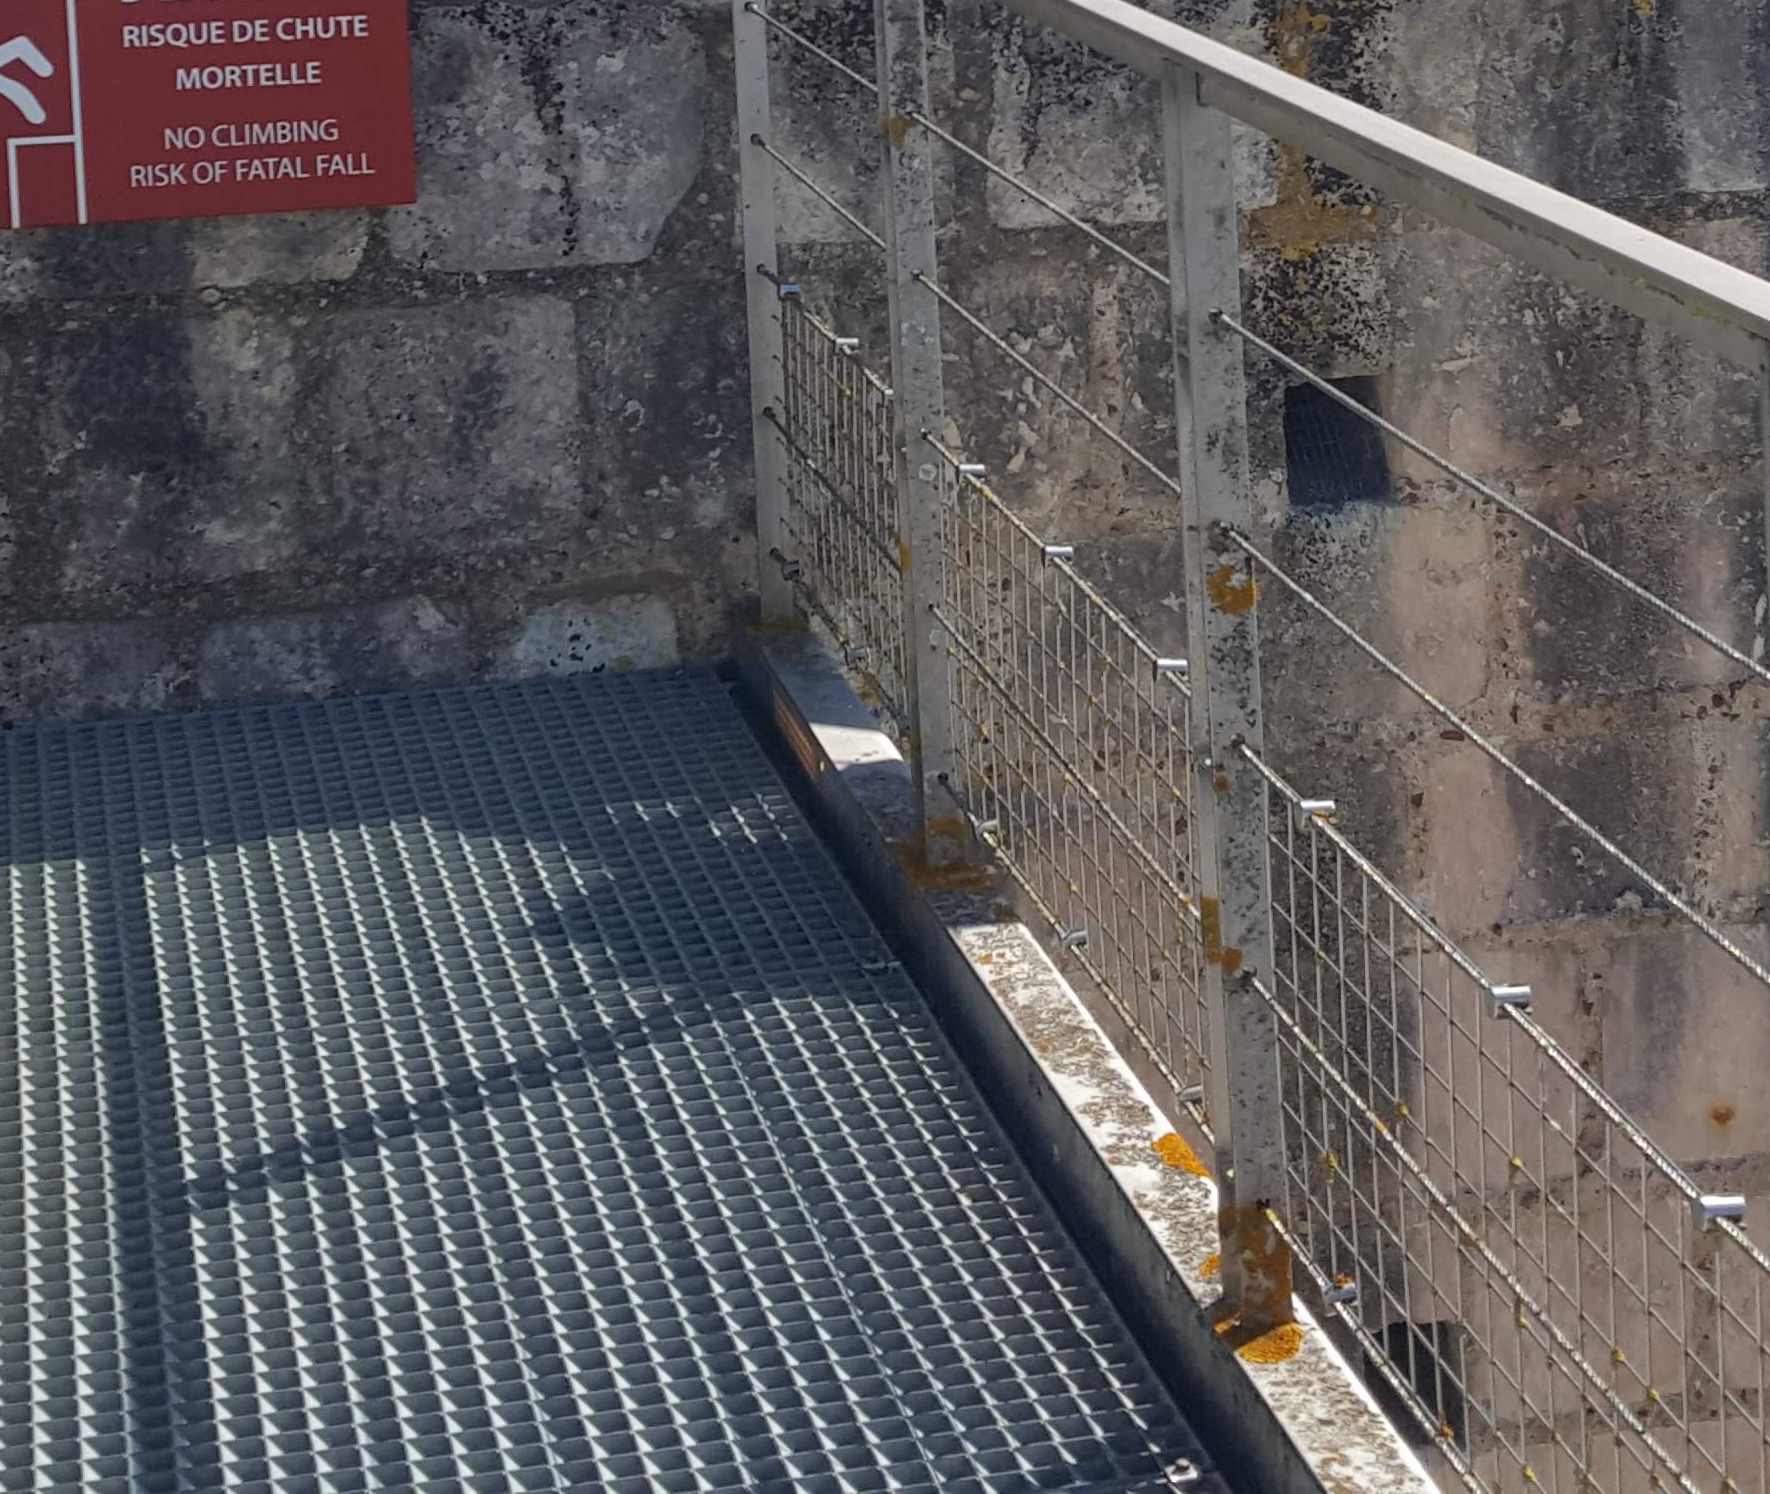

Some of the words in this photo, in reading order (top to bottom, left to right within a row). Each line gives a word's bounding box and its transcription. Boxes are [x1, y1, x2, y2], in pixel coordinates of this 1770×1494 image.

[123, 21, 225, 48] RISQUE
[232, 19, 270, 43] DE
[276, 15, 368, 40] CHUTE
[176, 61, 321, 90] MORTELLE
[164, 126, 205, 149] NO
[212, 119, 338, 147] CLIMBING
[131, 164, 186, 187] RISK
[192, 160, 227, 184] OF
[236, 157, 309, 181] FATAL
[316, 153, 374, 176] FALL
